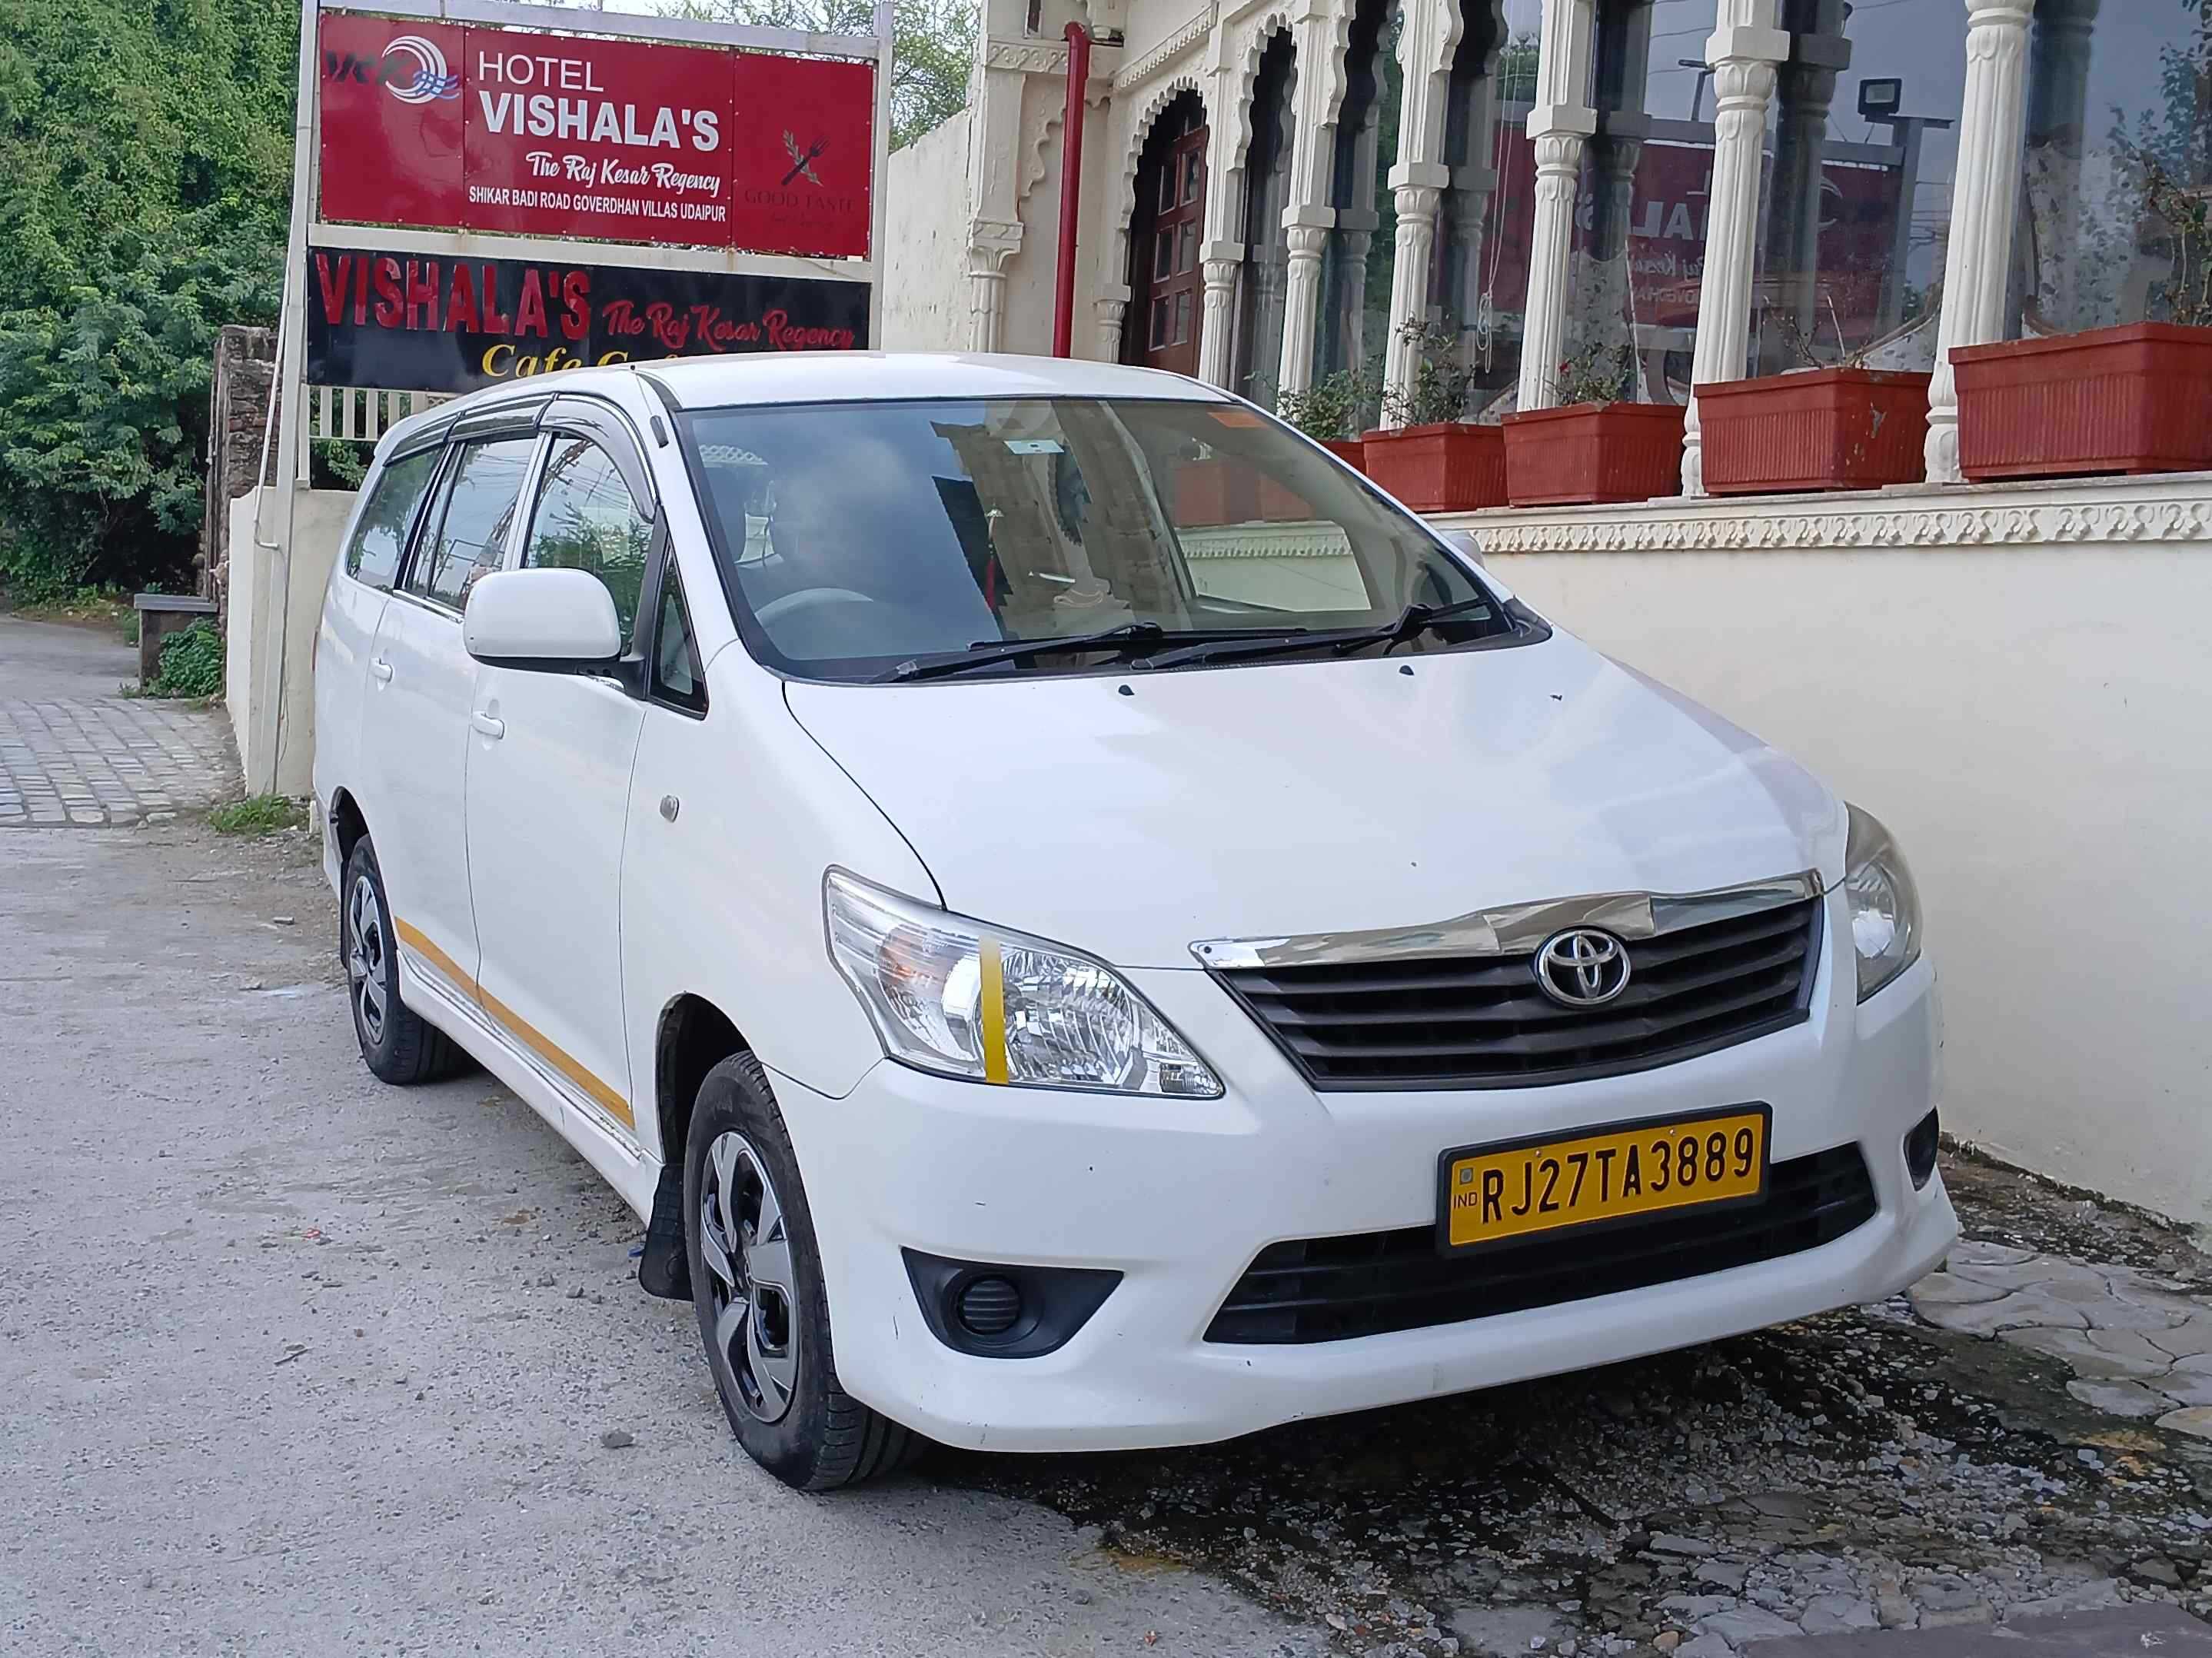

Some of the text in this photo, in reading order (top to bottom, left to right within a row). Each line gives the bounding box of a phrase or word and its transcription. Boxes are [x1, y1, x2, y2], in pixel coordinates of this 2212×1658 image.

[478, 51, 604, 92] HOTEL
[478, 90, 720, 152] VISHALA'S
[526, 151, 720, 198] The Raj Kesar Regency
[743, 189, 799, 208] GOOD
[468, 185, 727, 222] SHIKAR BADI ROAD GOVERDHAN VILLAS UDAIPUR
[315, 252, 591, 341] VISHALA'S
[602, 299, 855, 351] The Raj Kesar Regency
[1452, 1127, 1754, 1224] IND RJ27TA3889
